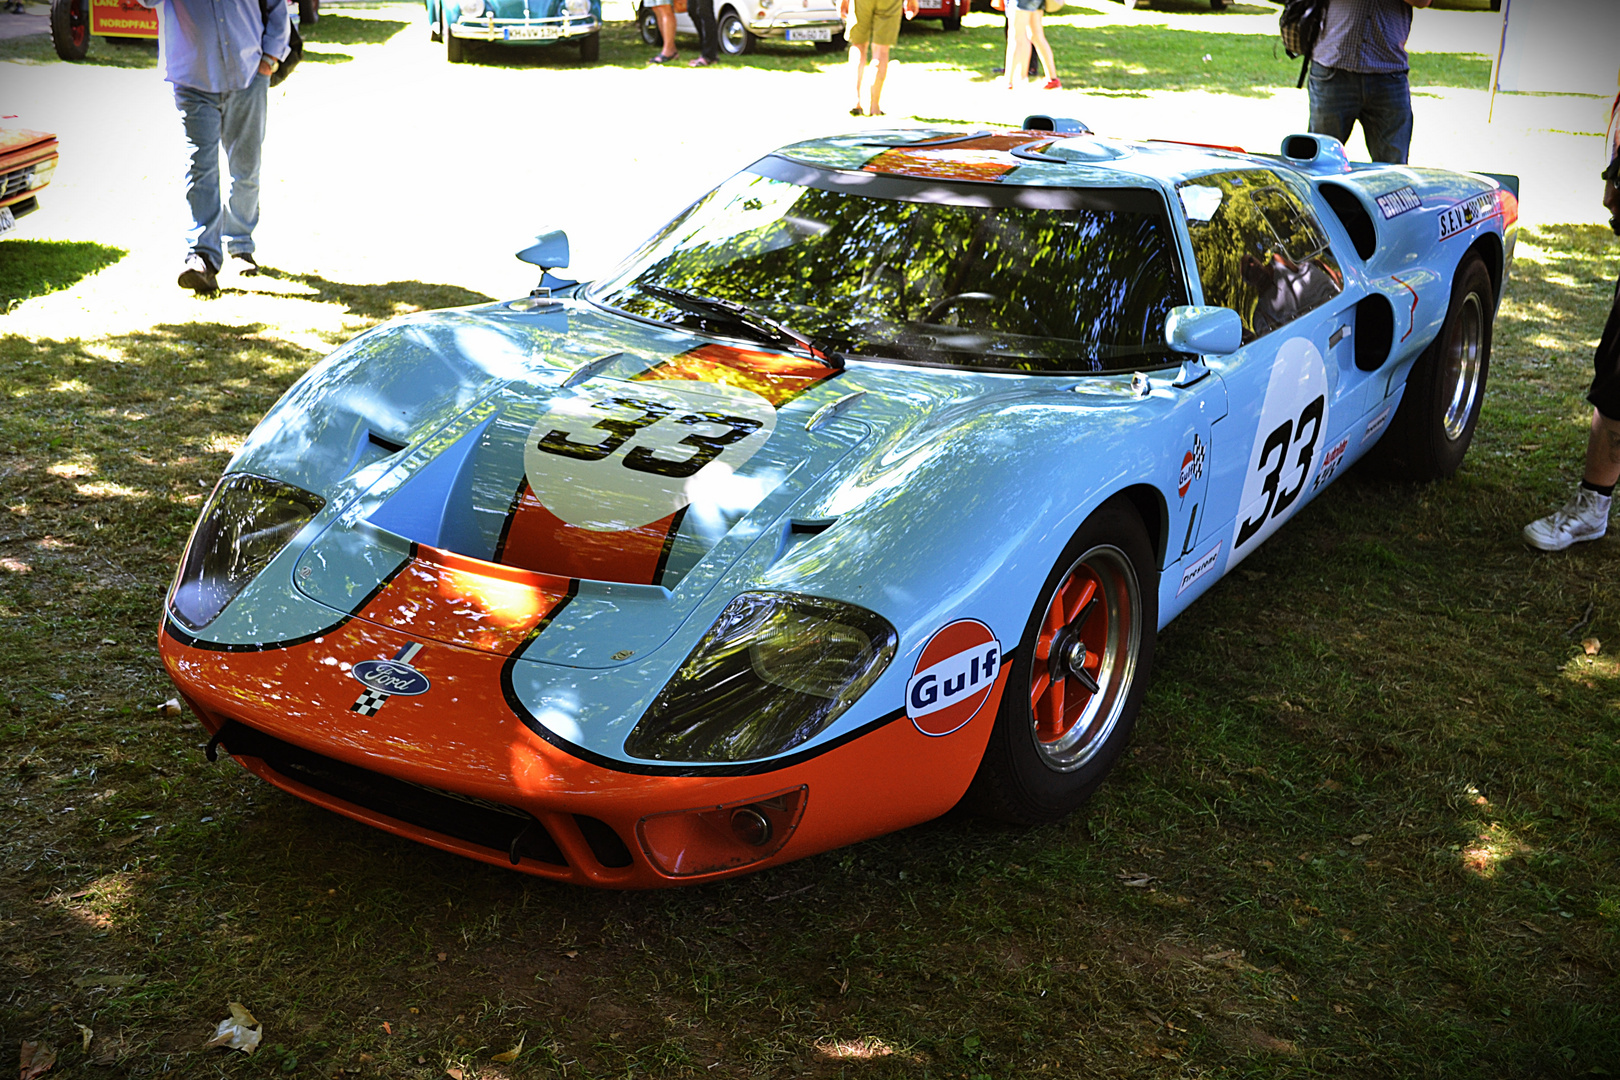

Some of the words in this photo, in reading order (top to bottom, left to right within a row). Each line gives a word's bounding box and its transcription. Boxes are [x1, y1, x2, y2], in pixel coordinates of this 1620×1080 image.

[99, 18, 158, 30] NORDPFALZ
[1377, 186, 1421, 218] GIRLING
[537, 397, 764, 479] 33
[1179, 463, 1195, 486] Gulf
[1234, 394, 1325, 550] 33
[1182, 552, 1218, 588] Firestone
[364, 664, 417, 691] Ford
[910, 648, 998, 710] Gulf
